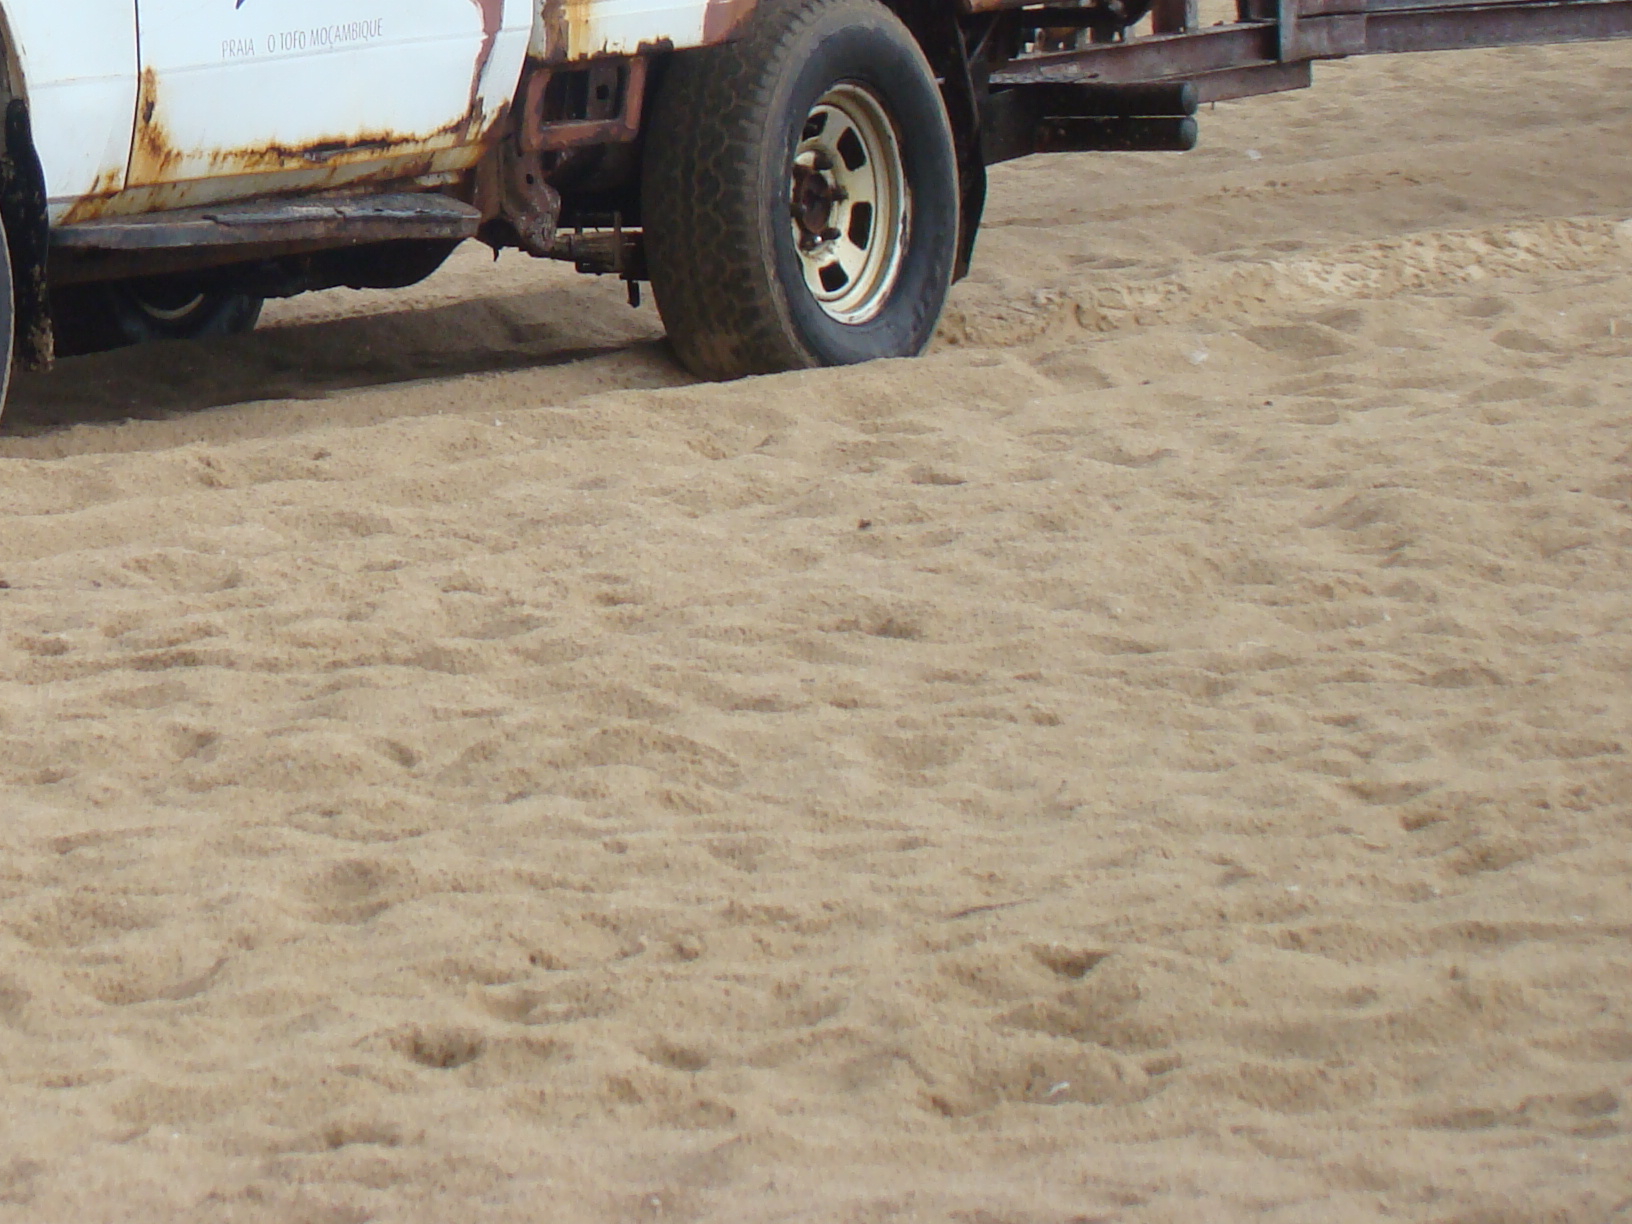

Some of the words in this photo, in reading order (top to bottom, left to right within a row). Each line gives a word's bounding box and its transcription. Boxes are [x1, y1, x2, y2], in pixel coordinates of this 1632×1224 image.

[221, 37, 255, 58] PRAIA
[280, 30, 306, 50] TOFO
[309, 18, 383, 48] MOÇAMBIQUE
